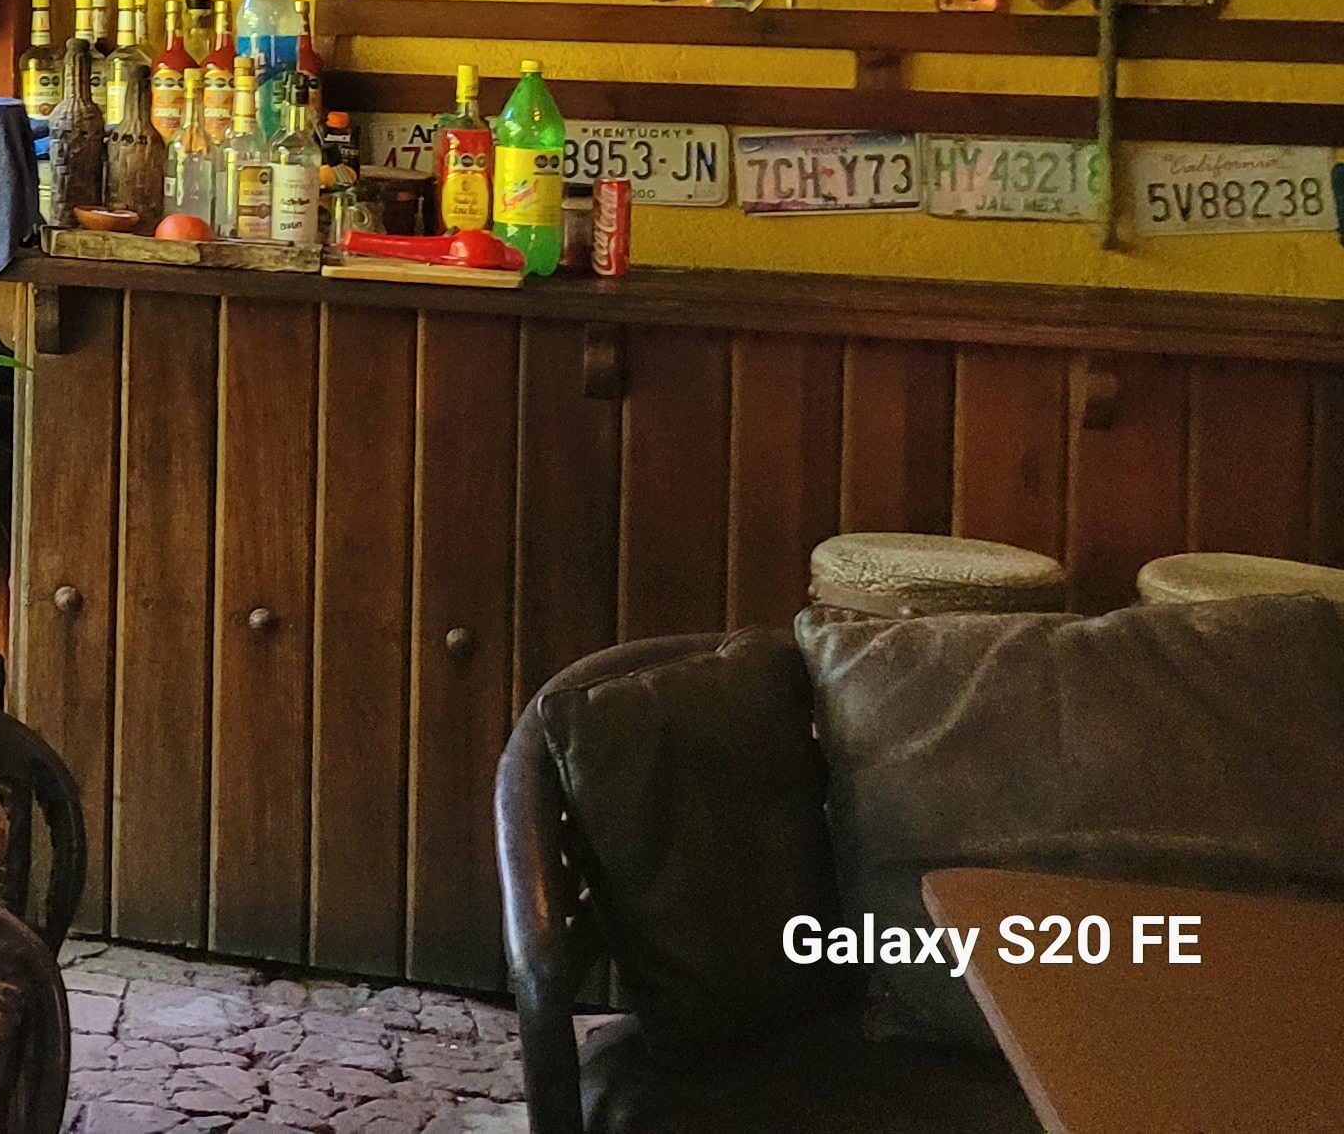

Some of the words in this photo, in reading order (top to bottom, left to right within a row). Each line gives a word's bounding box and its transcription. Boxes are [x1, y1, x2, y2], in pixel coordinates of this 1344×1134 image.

[591, 127, 682, 139] KENTUCKY
[802, 147, 850, 156] TRUCK
[1147, 177, 1324, 222] 5V88238
